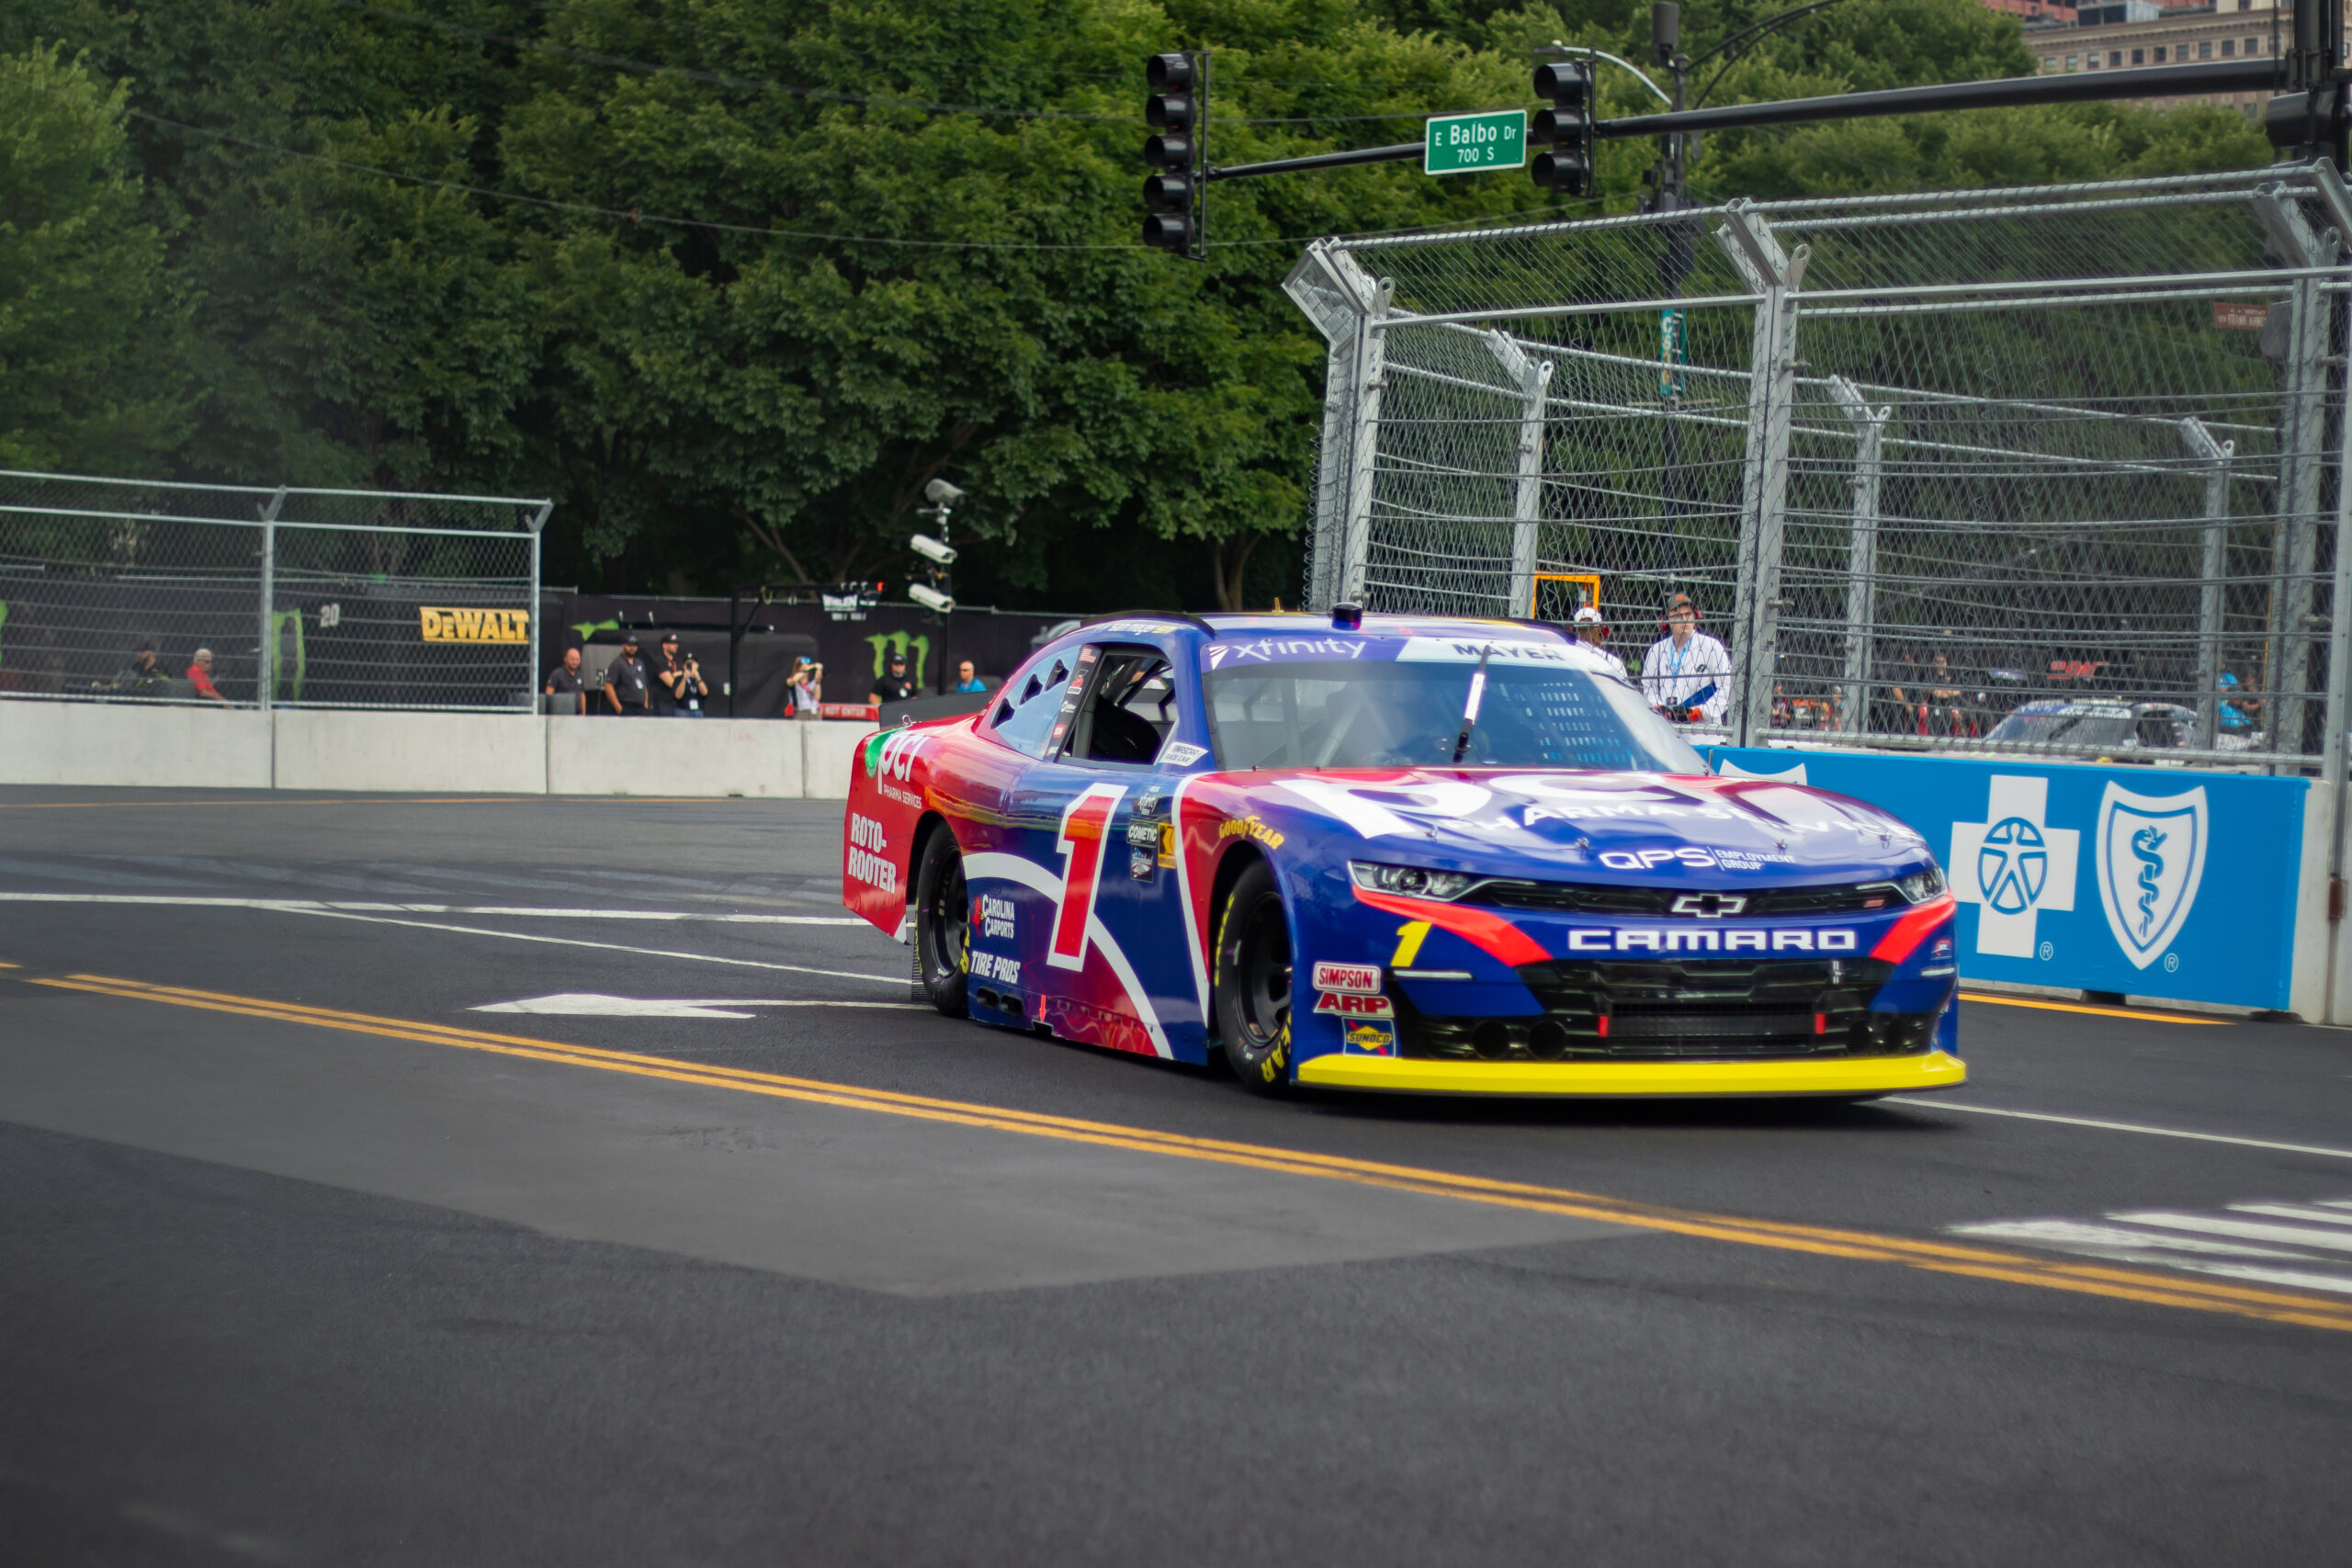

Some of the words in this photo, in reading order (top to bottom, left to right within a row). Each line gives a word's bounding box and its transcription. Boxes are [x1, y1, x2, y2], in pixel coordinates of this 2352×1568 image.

[1435, 132, 1442, 146] E
[1450, 122, 1497, 145] Balbo
[1504, 125, 1517, 140] Dr
[1457, 148, 1479, 163] 700
[1487, 146, 1495, 161] S
[320, 604, 341, 627] 20
[1236, 637, 1367, 661] xfinity
[1453, 643, 1566, 660] MAYER
[884, 784, 901, 802] PHARMA
[902, 791, 922, 809] SERVICES
[851, 812, 888, 853] ROTO-
[1128, 826, 1157, 842] COMETIC
[1219, 816, 1284, 850] GOODYEAR
[1599, 848, 1716, 869] QPS
[1715, 850, 1795, 863] EMPLOYMENT
[1722, 858, 1762, 871] GROUP
[848, 846, 897, 894] ROOTER
[1046, 783, 1129, 973] 1
[982, 894, 1015, 920] CAROLINA
[985, 917, 1014, 939] CARPORTS
[1390, 921, 1432, 967] 1
[1568, 931, 1855, 950] CAMARO
[970, 951, 994, 977] TIRE
[992, 956, 1021, 984] PROS
[1318, 967, 1374, 988] SIMPSON
[1317, 992, 1389, 1013] ARP
[1348, 1032, 1391, 1044] SUNOCO
